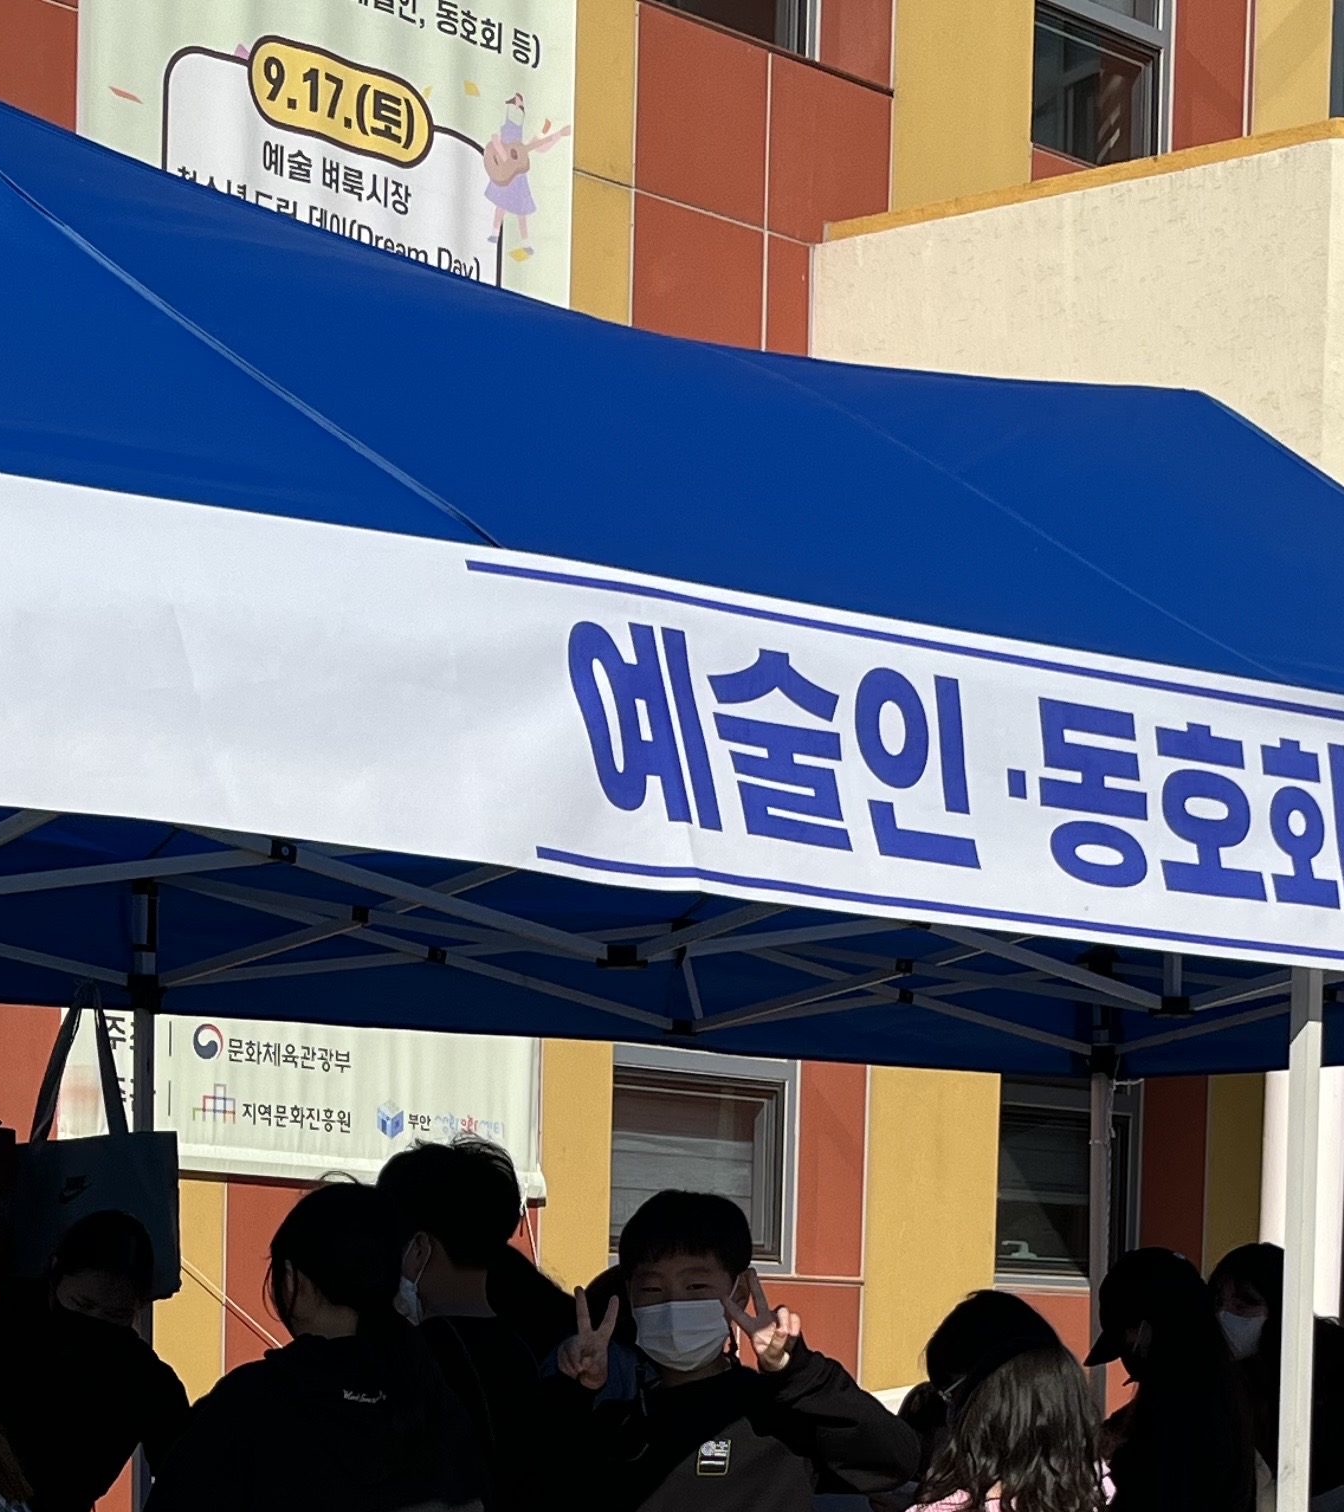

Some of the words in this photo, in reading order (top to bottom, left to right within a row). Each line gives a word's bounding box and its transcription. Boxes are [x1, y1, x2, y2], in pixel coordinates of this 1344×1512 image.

[436, 0, 502, 54] 동호회
[512, 27, 540, 68] 등)
[262, 55, 415, 150] 9.17.(토)
[263, 140, 313, 184] 예술
[321, 155, 412, 217] 벼룩시장
[568, 619, 981, 871] 예술인
[227, 1038, 352, 1074] 문화체육관광부
[241, 1102, 352, 1134] 지역문화진흥원
[407, 1113, 431, 1131] 부안
